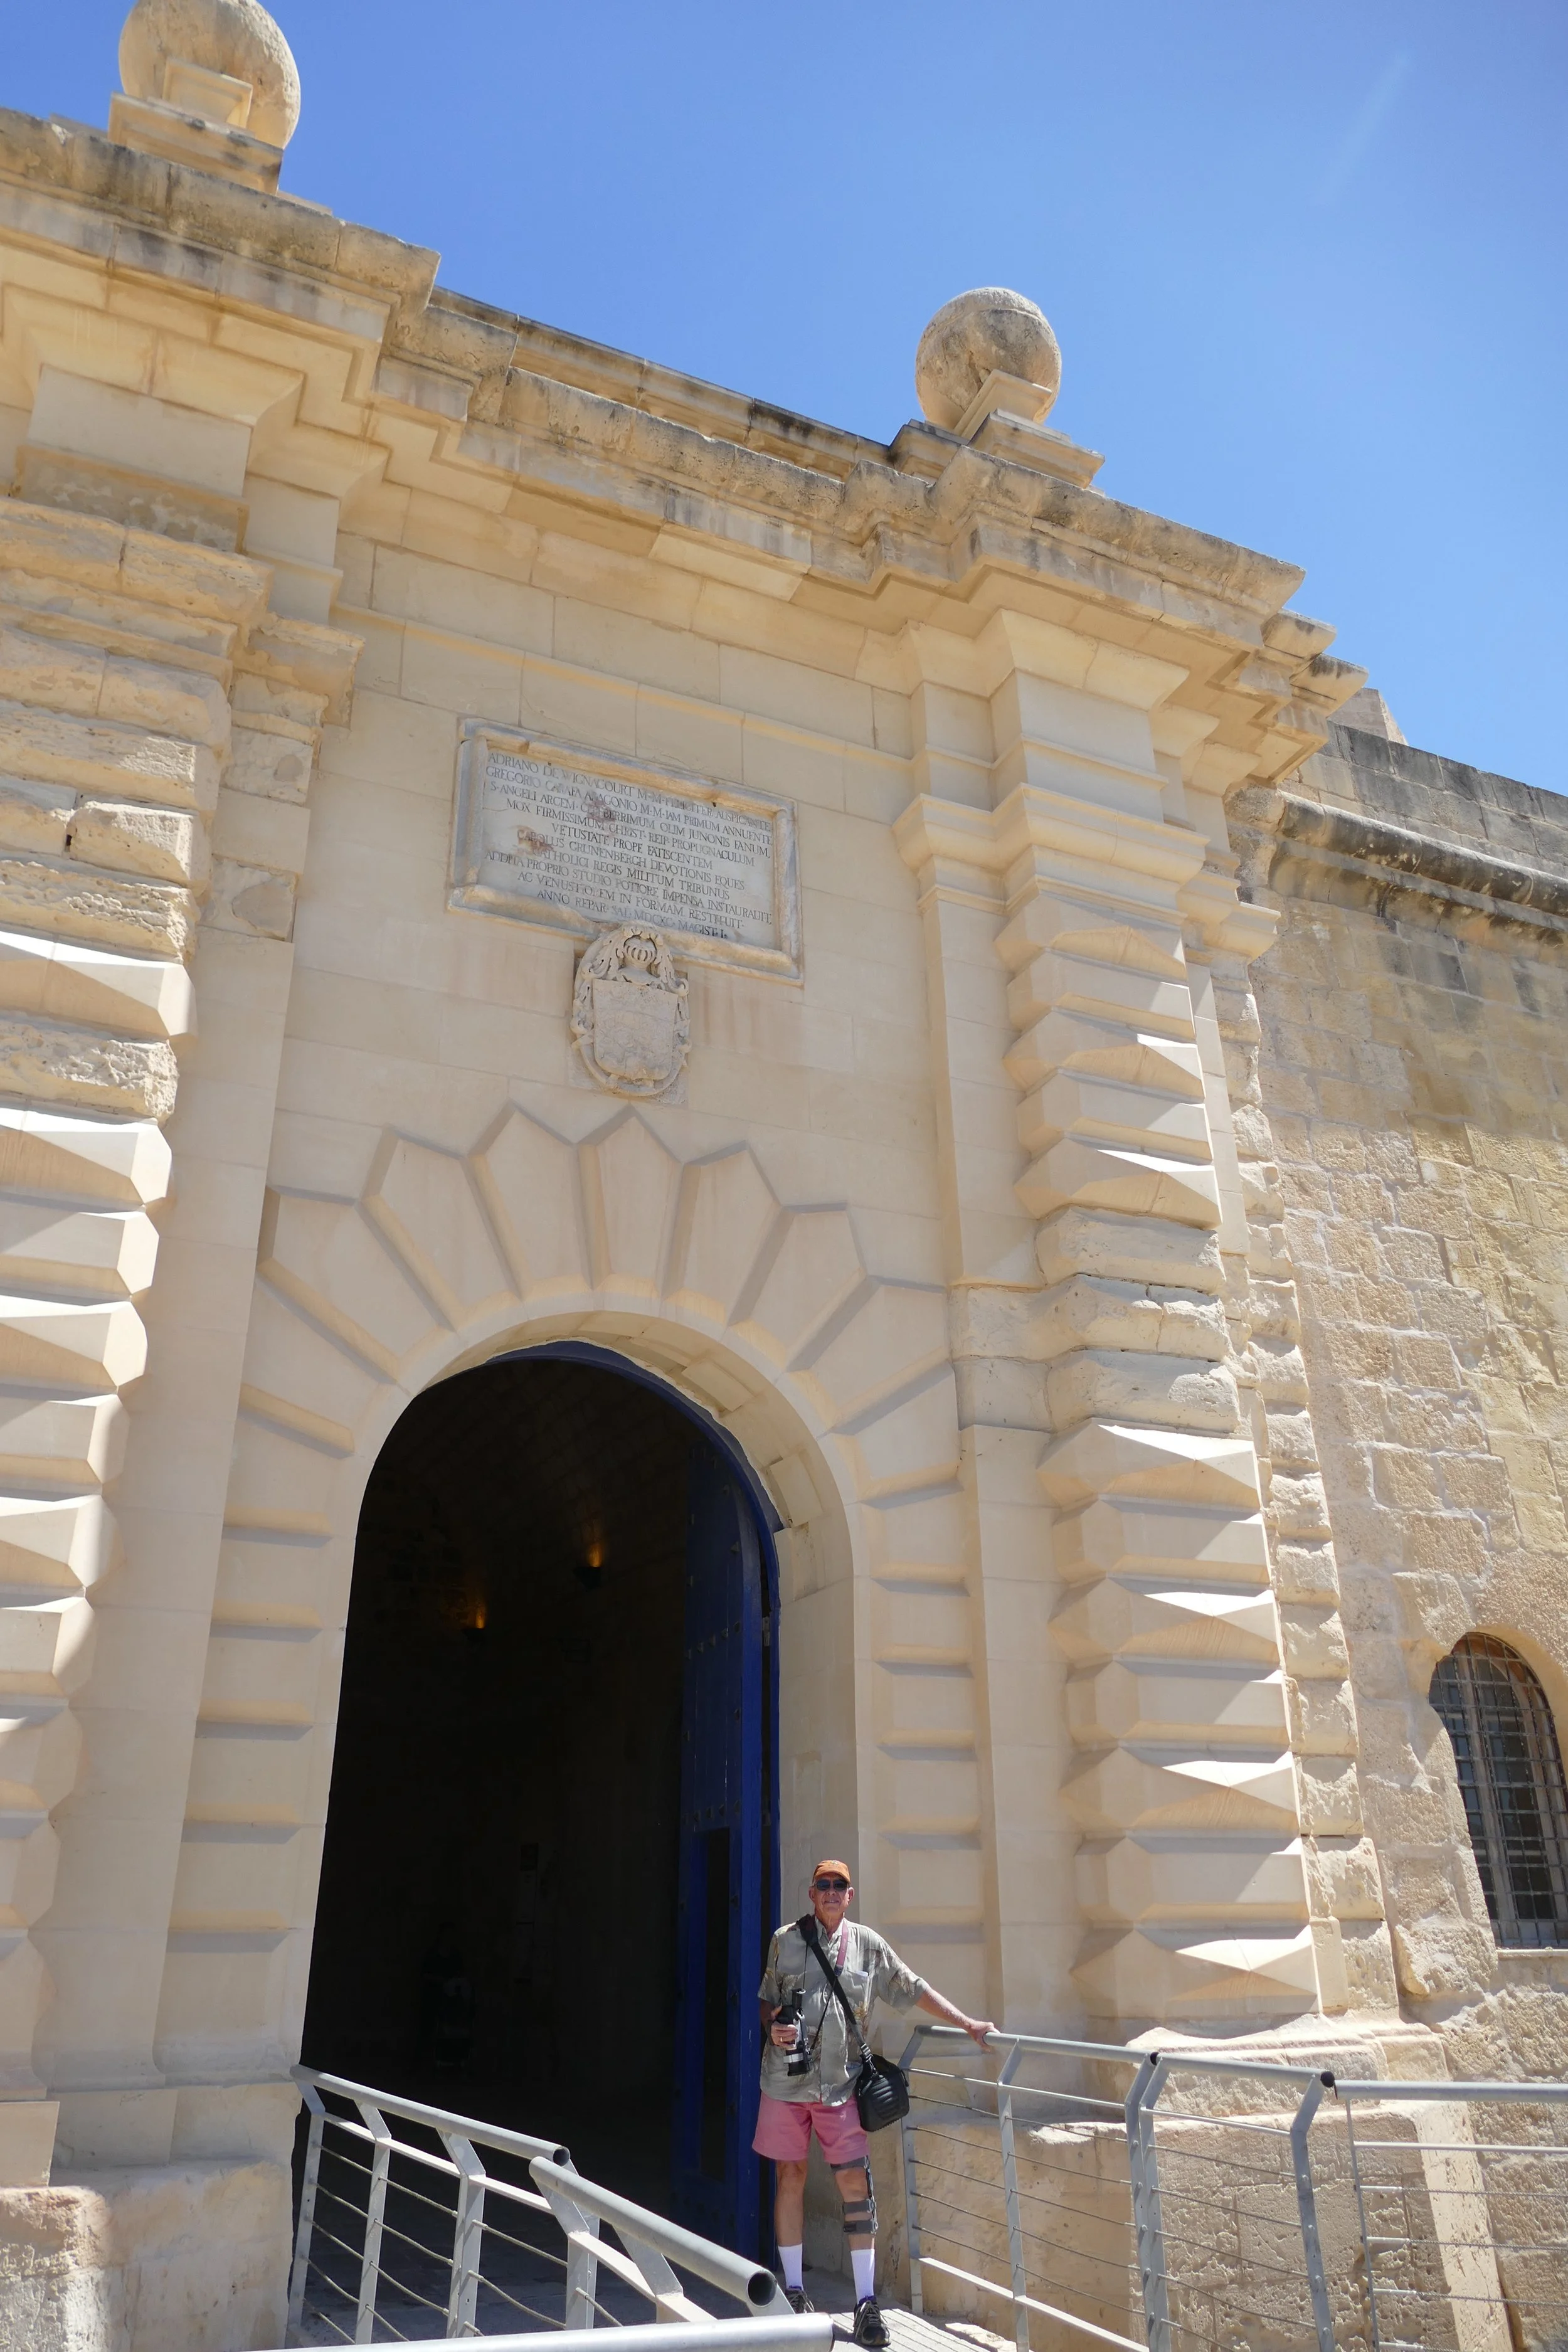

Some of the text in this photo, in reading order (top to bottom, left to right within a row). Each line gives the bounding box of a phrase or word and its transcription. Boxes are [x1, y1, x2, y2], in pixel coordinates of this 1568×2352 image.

[488, 751, 538, 774] ADRIANO
[485, 765, 541, 788] GREGORIO
[585, 789, 637, 812] AAGONIO
[684, 814, 719, 832] PRIMUM
[506, 798, 531, 813] MOX
[536, 805, 604, 831] FIRMISSIMUM
[551, 822, 609, 845] VETUSTATE
[613, 837, 642, 854] PROPE
[660, 822, 685, 837] OLIM
[688, 829, 729, 849] JUNONIS
[517, 869, 532, 883] AC
[620, 892, 631, 904] IN
[526, 858, 568, 877] PROPRIO
[572, 868, 611, 886] STUDIO
[662, 889, 704, 908] IMPENSA
[593, 859, 622, 875] REGIS
[627, 867, 674, 887] MILITUM
[679, 879, 729, 901] TRIBUNUS
[650, 859, 711, 883] DEVOTIONIS
[715, 874, 744, 893] EQUES
[537, 888, 569, 904] ANNO
